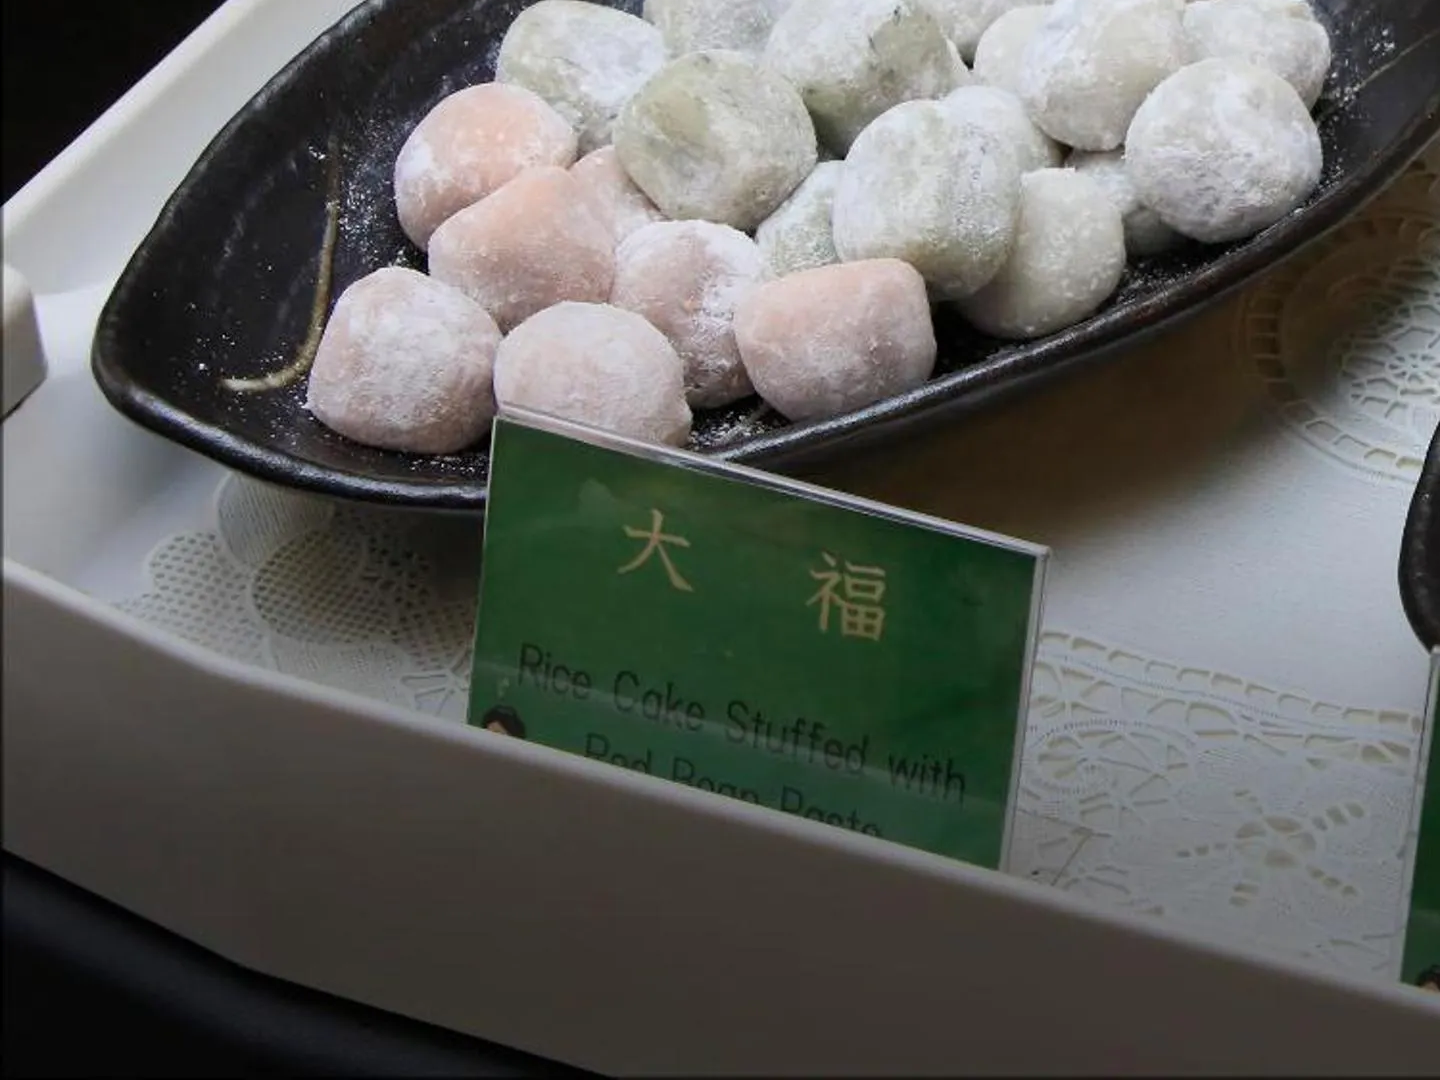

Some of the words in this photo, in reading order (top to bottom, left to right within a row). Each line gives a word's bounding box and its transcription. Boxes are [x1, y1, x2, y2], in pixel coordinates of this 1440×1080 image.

[518, 642, 592, 702] Rice
[614, 670, 705, 732] Cake
[726, 700, 870, 778] Stuffed
[889, 754, 966, 804] with
